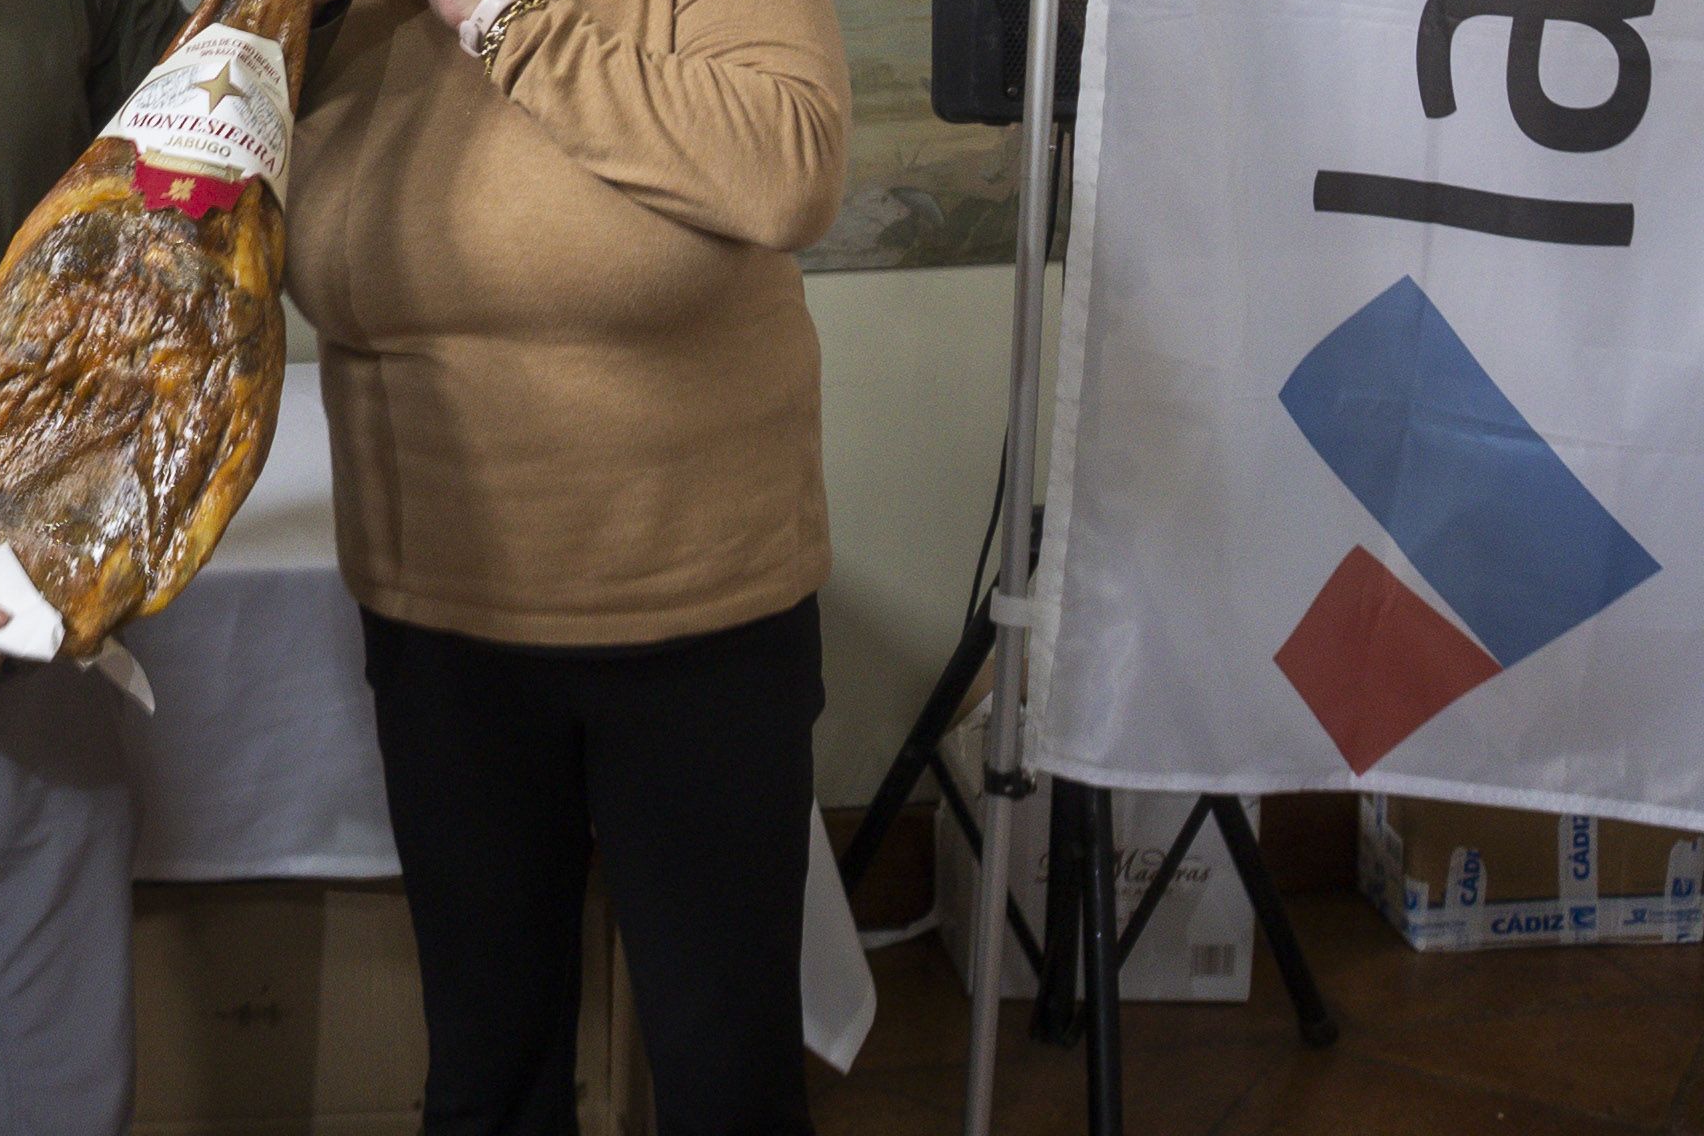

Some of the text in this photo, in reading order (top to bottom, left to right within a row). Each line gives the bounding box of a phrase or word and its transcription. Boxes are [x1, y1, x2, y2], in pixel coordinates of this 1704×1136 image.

[126, 111, 277, 172] MONTESIERRA
[164, 135, 232, 158] JABUGO
[1491, 913, 1564, 935] CÁDIZ
